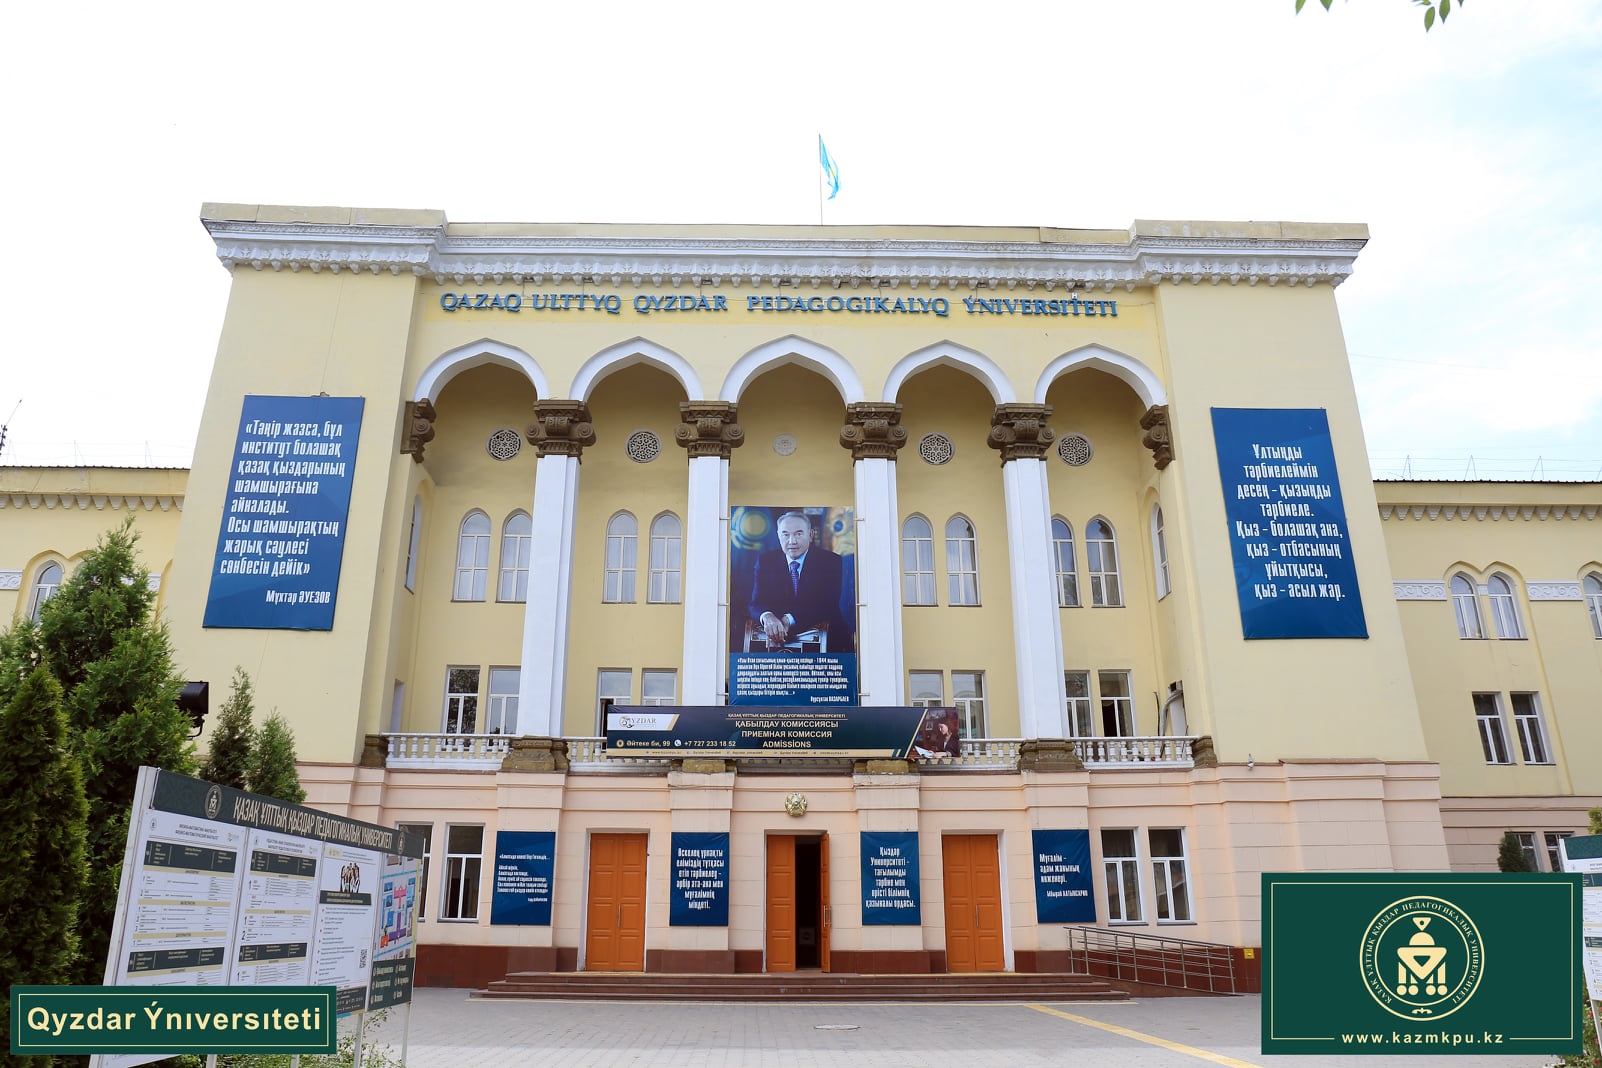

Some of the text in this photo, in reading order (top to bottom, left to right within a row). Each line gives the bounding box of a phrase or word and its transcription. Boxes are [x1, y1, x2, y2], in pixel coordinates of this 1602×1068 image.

[440, 293, 522, 312] QAZAQ
[532, 293, 621, 314] ULTTYQ
[633, 294, 728, 313] QYZDAR
[746, 295, 949, 316] PEDAGOGIKALYQ
[246, 420, 342, 439] «Тәңір жазса, бұл
[242, 440, 340, 458] институт болашақ
[1252, 444, 1302, 460] Ұлтыңды
[238, 460, 345, 478] қазақ қыздарының
[1243, 462, 1318, 480] тәрбиелеймін
[234, 479, 318, 496] шамшырағына
[1238, 484, 1270, 500] десең
[1280, 484, 1331, 500] қызыңды
[231, 498, 290, 515] айналады.
[1260, 502, 1314, 520] тәрбиеле.
[228, 516, 339, 537] Осы шамшырақтың
[1236, 520, 1260, 539] Қыз
[1270, 521, 1319, 538] болашақ
[1320, 524, 1343, 538] ана,
[224, 538, 309, 558] жарық сәулесі
[1247, 544, 1269, 559] қыз
[1280, 540, 1342, 559] отбасының
[220, 558, 310, 577] сөнбесін дейік»
[1265, 561, 1328, 580] ұйытқысы,
[266, 590, 330, 606] Мұхтар ӘУЕЗОВ
[1255, 584, 1278, 600] қыз
[1288, 584, 1317, 598] асыл
[1319, 584, 1346, 602] жар.
[736, 720, 780, 728] ҚАБЫЛДАУ
[234, 796, 260, 826] ҚАЗАҚ
[260, 802, 289, 832] ҰЛТТЫҚ
[288, 808, 315, 836] ҚЫЗДАР
[314, 816, 362, 846] ПЕДАГОГИКАЛЫҚ
[880, 846, 900, 858] Қыздар
[1040, 854, 1062, 864] Мұғалім
[870, 857, 906, 867] Университеті
[1040, 865, 1080, 874] адам жанының
